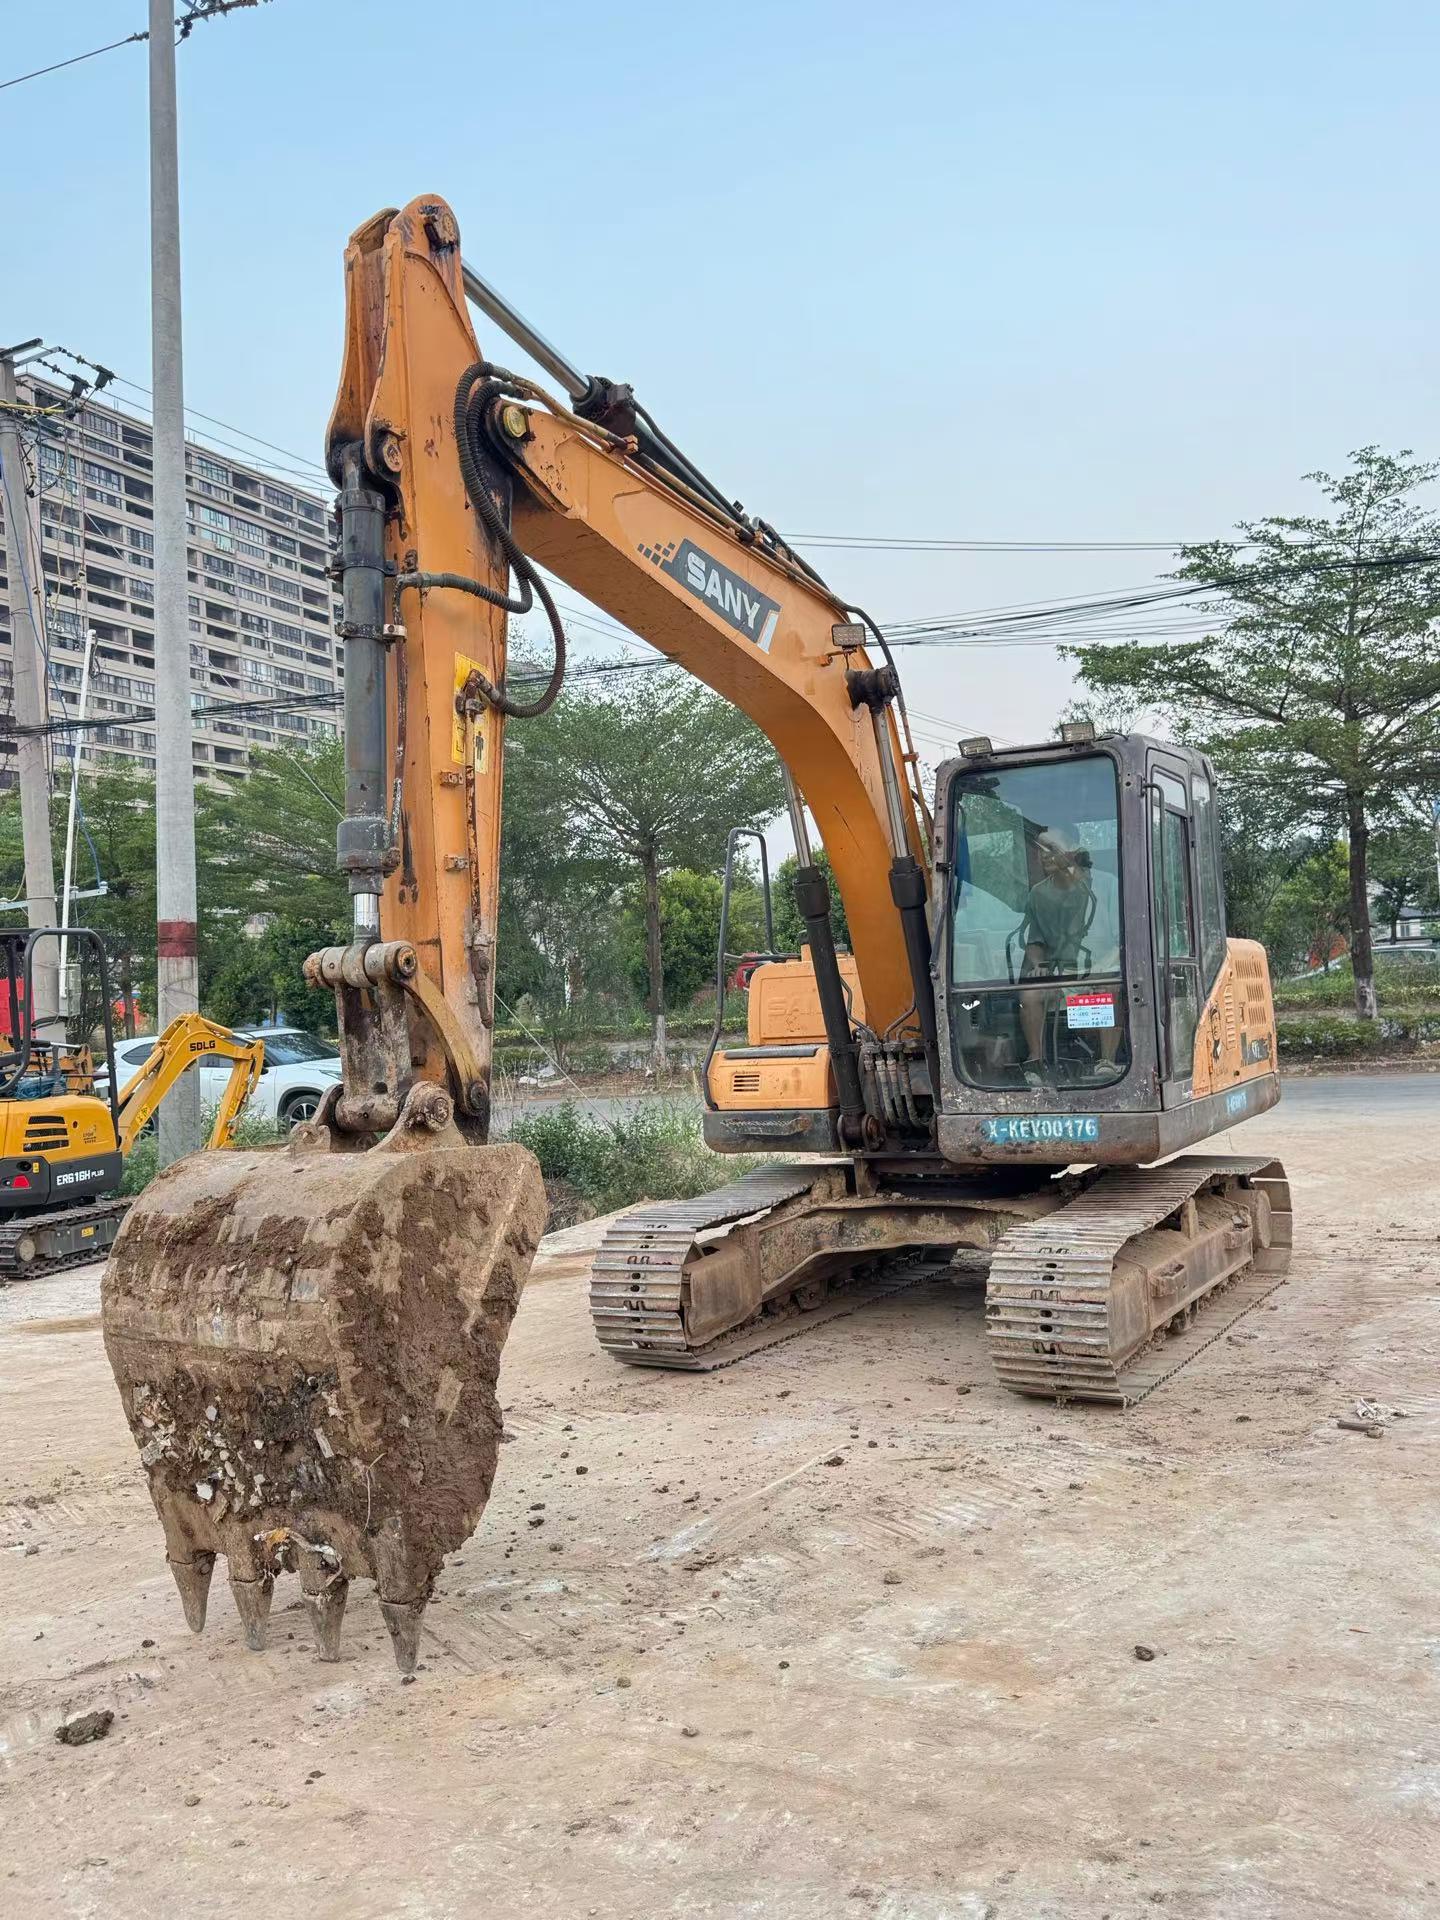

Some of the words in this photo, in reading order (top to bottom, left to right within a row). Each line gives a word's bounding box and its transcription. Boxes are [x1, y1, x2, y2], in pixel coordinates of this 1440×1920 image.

[687, 551, 761, 630] SANY
[189, 1040, 216, 1052] SDLG
[56, 1169, 91, 1186] ER616H
[91, 1169, 105, 1178] PLUS
